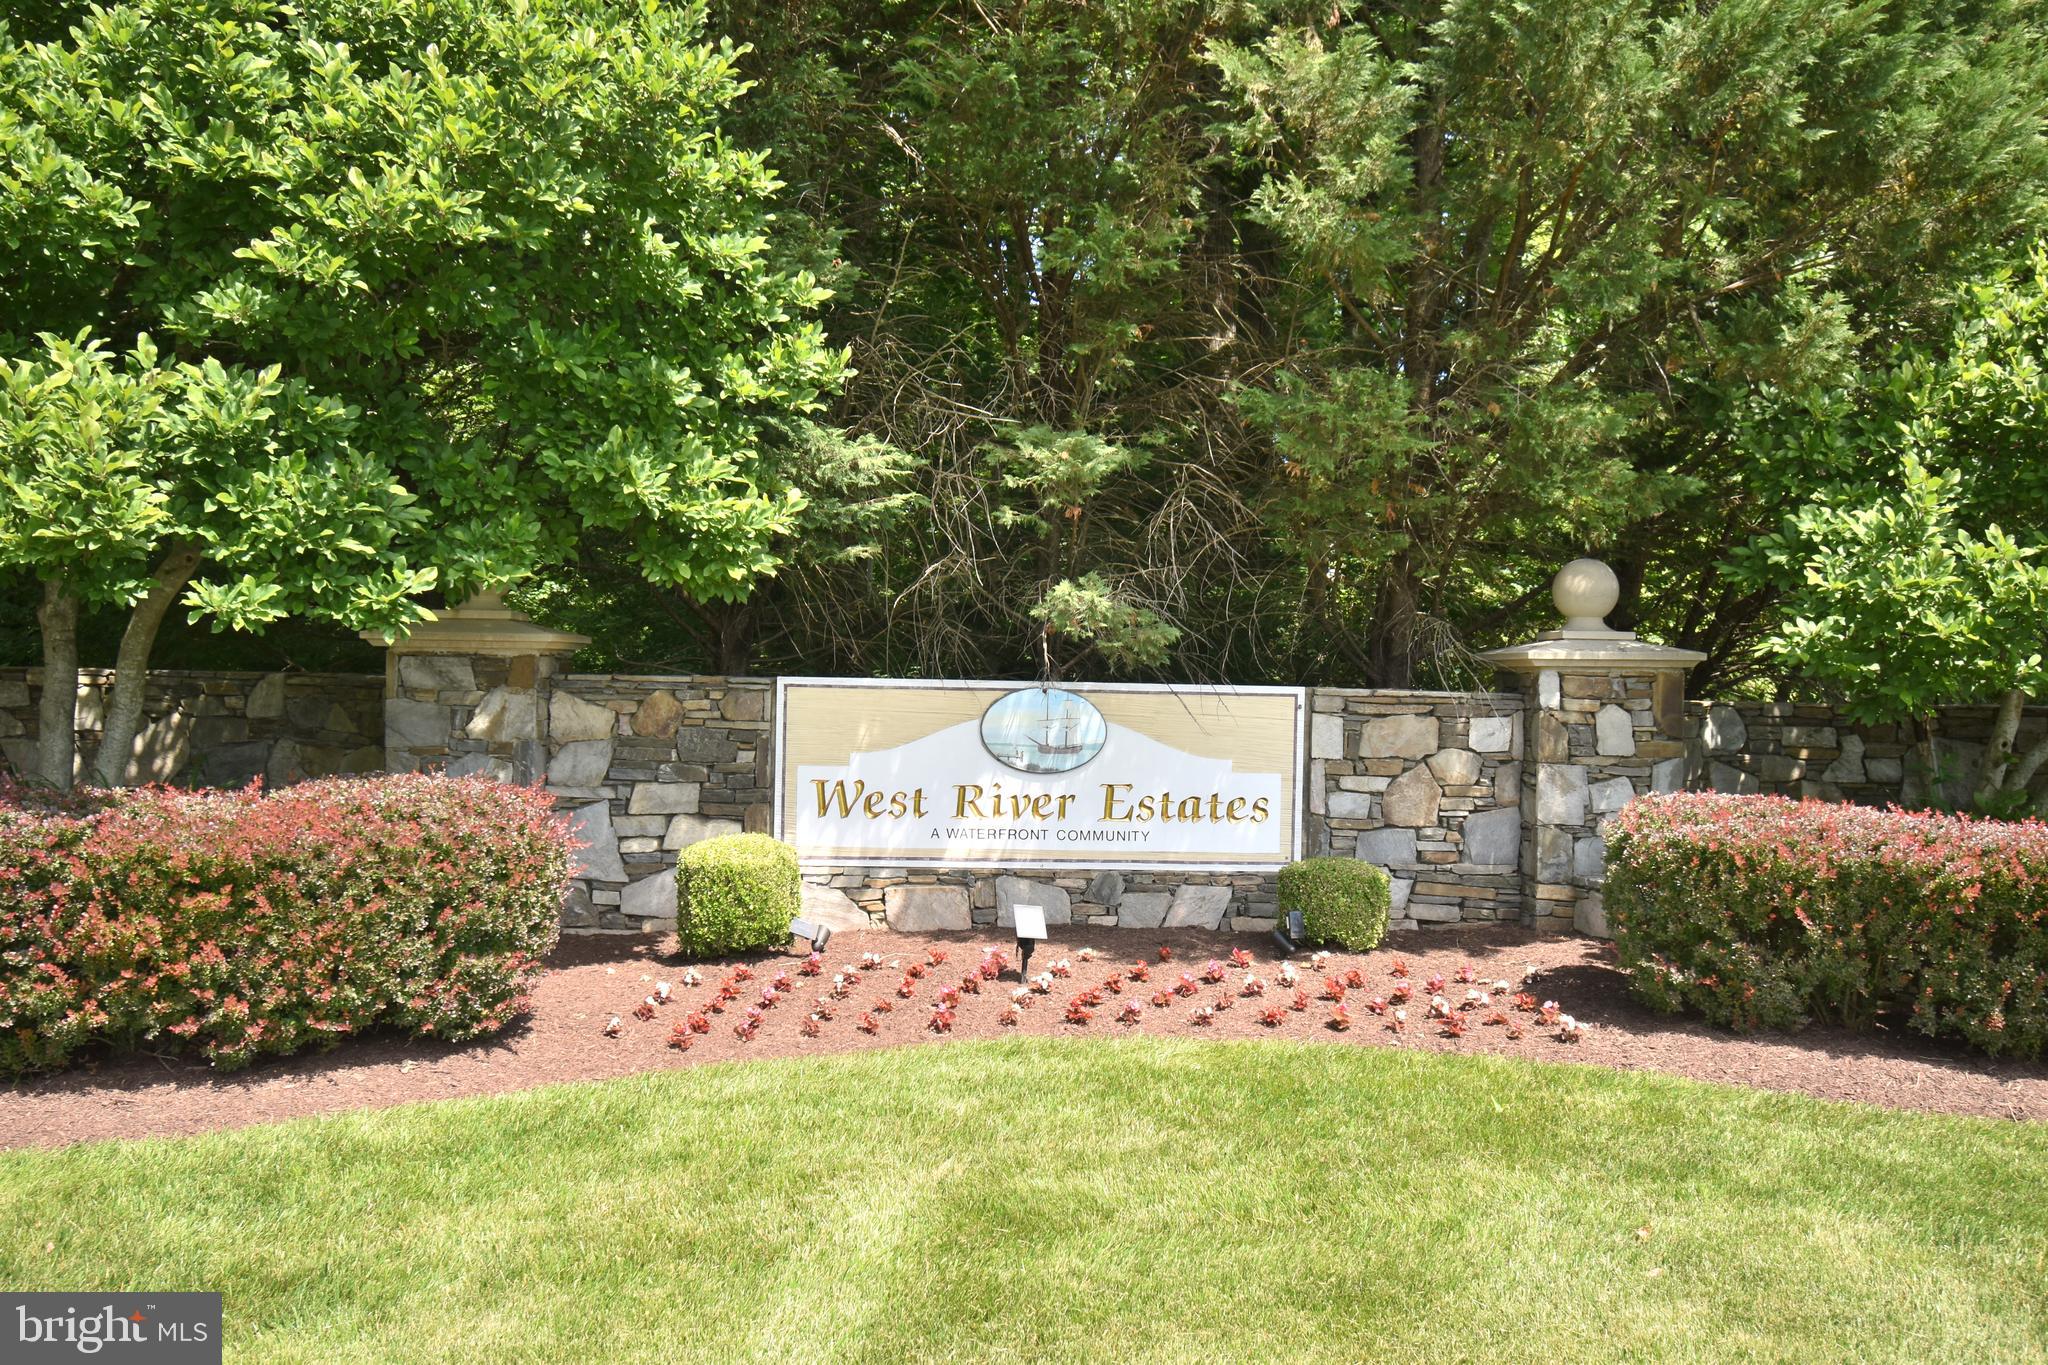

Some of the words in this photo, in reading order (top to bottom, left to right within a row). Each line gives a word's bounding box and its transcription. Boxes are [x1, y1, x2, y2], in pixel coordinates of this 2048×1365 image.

[811, 779, 929, 819] West
[952, 783, 1076, 822] River
[1100, 784, 1269, 824] Estates
[930, 829, 941, 841] A
[946, 828, 1048, 841] WATERFRONT
[1056, 829, 1151, 843] COMMUNITY
